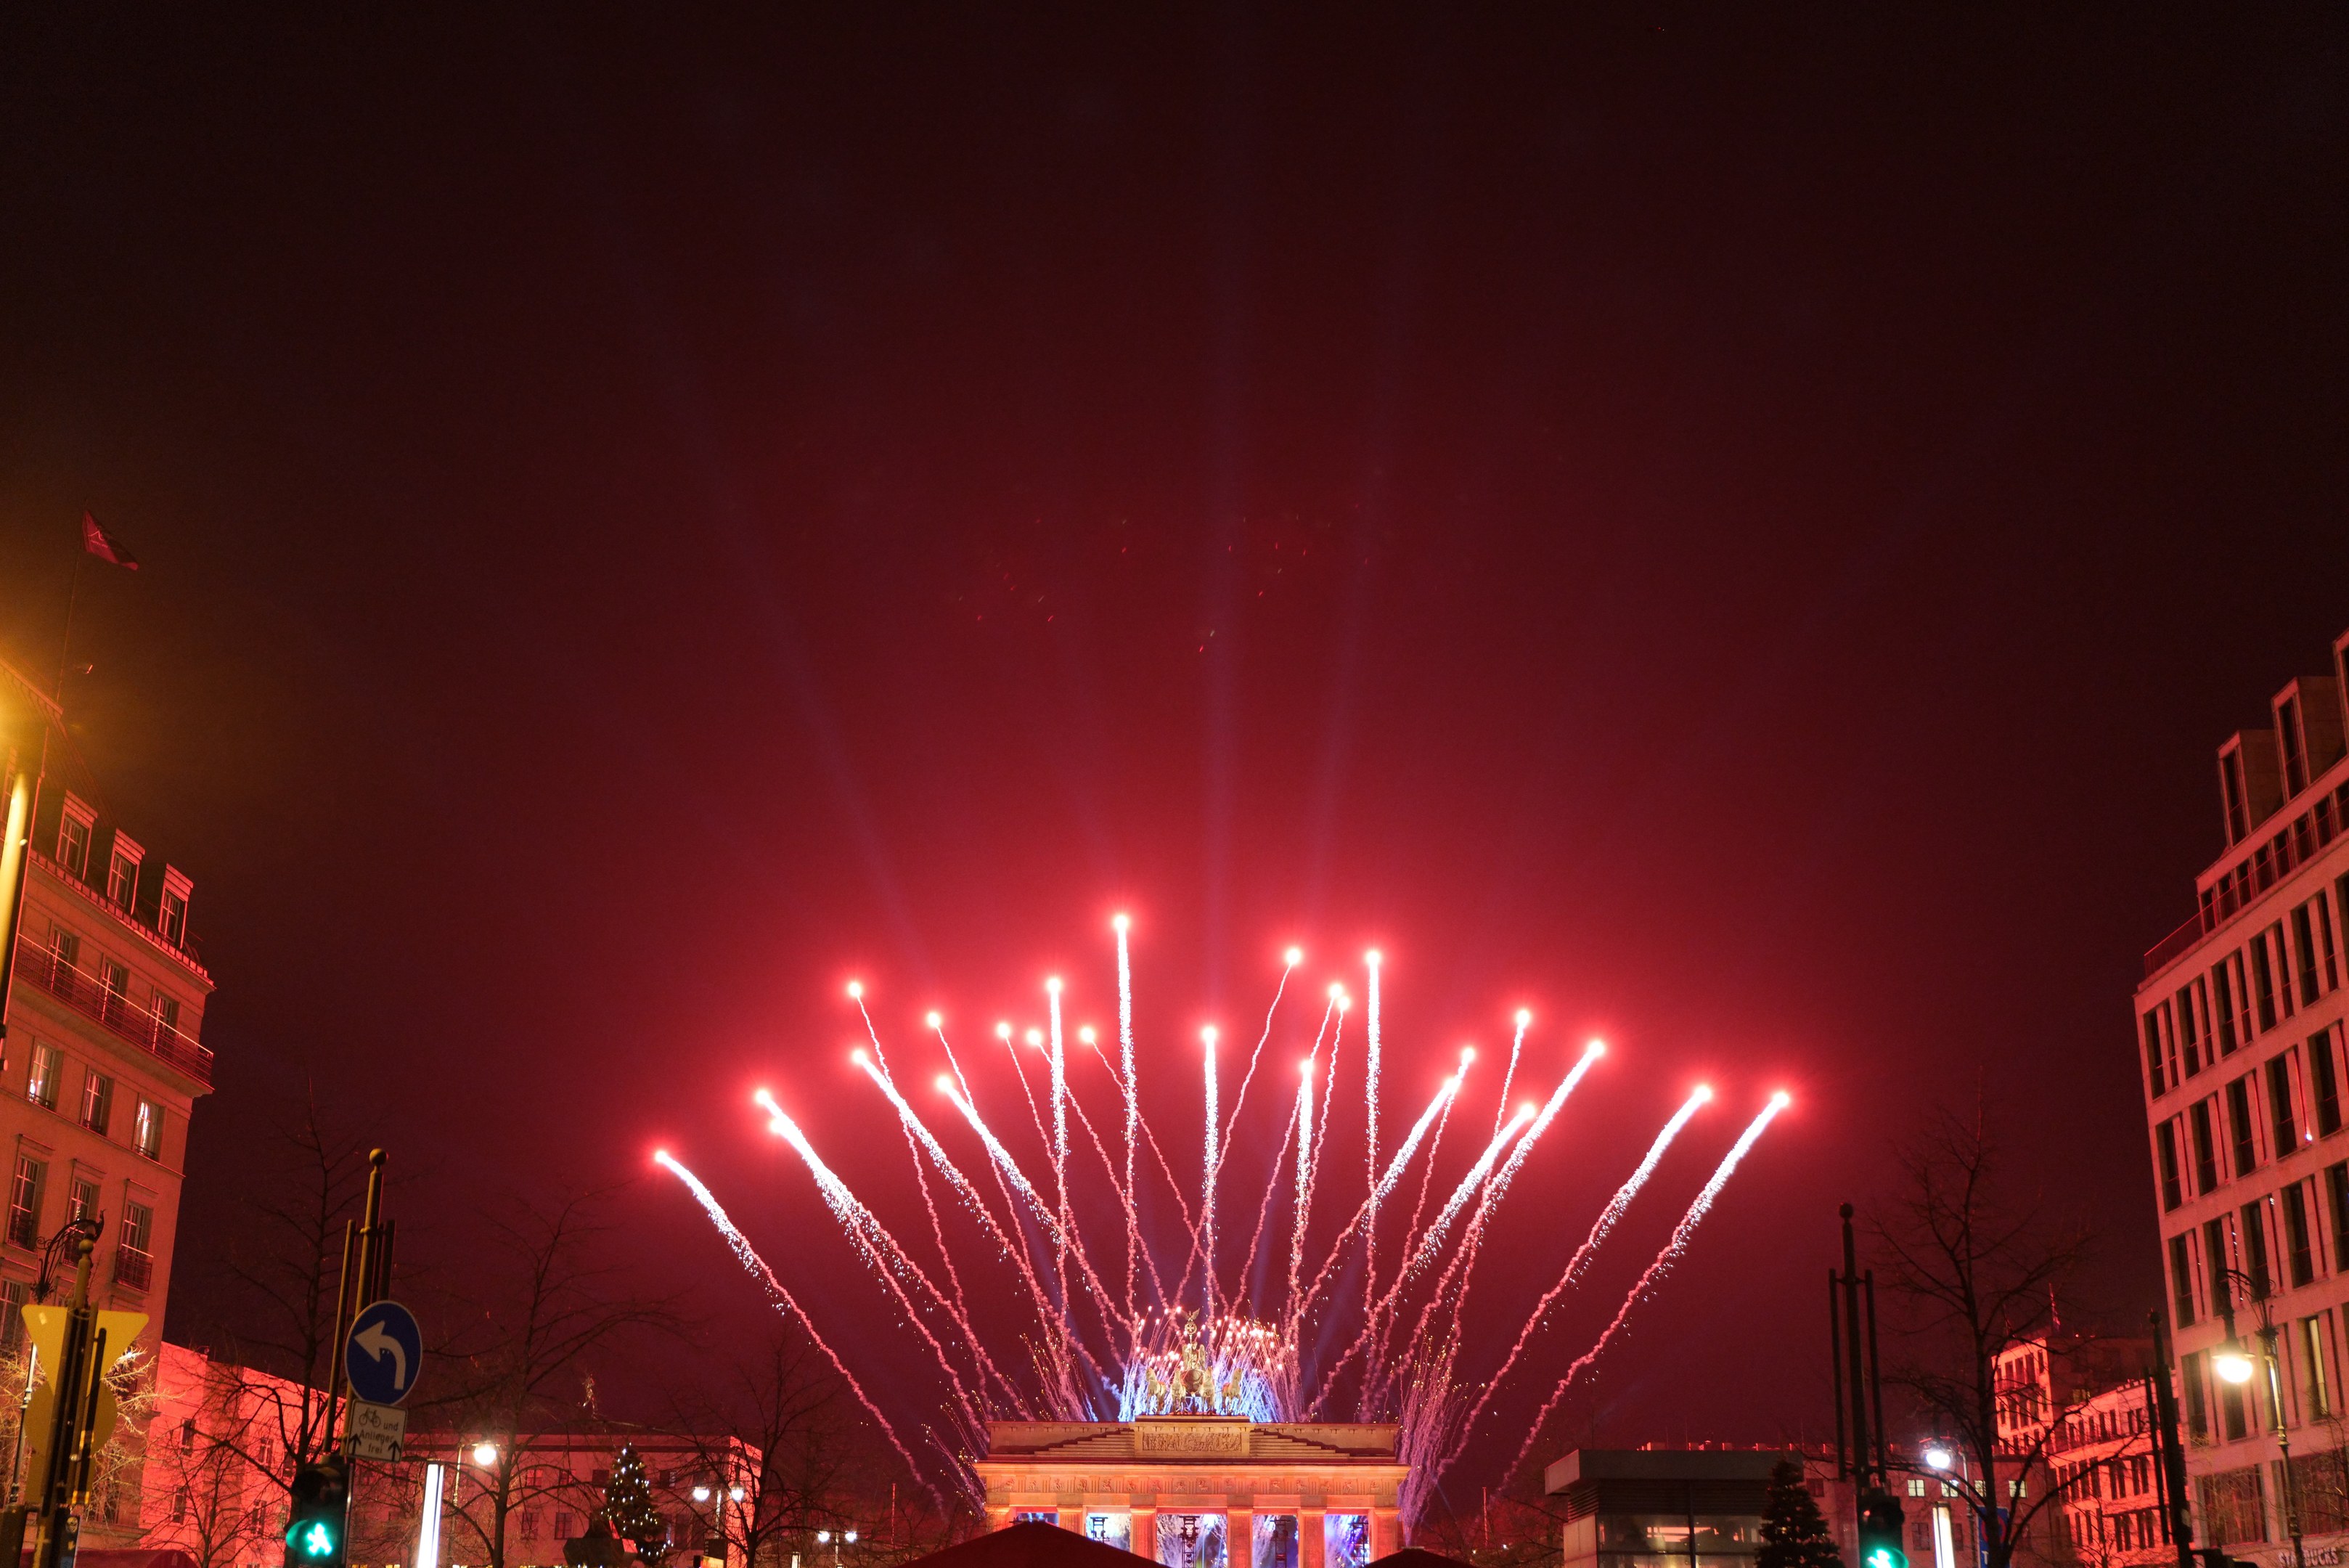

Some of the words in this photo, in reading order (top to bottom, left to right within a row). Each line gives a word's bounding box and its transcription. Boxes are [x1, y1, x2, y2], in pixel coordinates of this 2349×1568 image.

[383, 1423, 399, 1432] und
[359, 1429, 394, 1445] Anlieger
[368, 1443, 383, 1453] frei
[2278, 1546, 2339, 1567] STABUCKS
